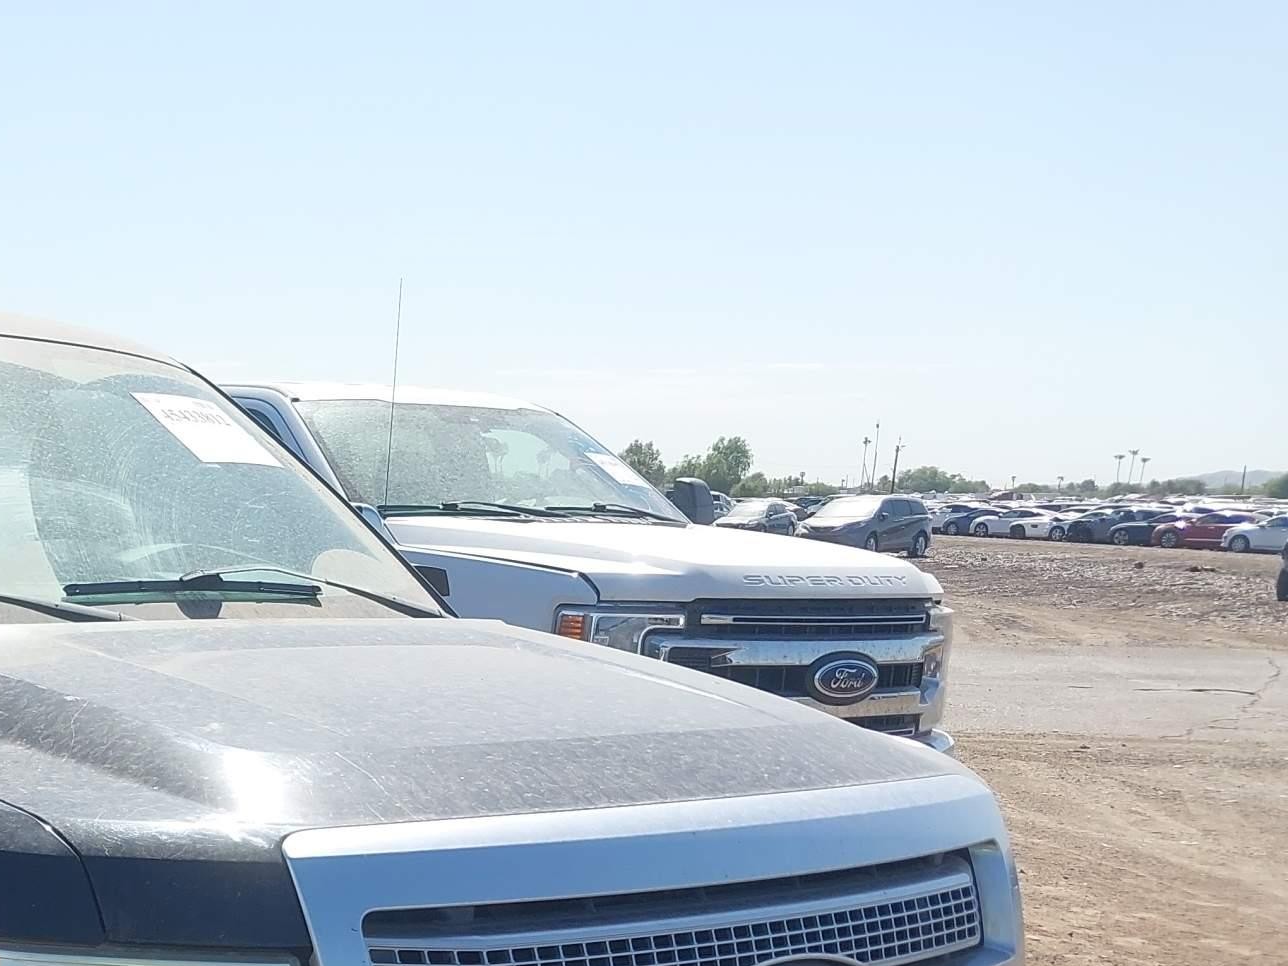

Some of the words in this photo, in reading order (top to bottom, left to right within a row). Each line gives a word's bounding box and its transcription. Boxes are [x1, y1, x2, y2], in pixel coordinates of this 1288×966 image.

[743, 575, 844, 587] SUPER
[845, 575, 907, 587] DUTY
[830, 667, 866, 689] Ford
